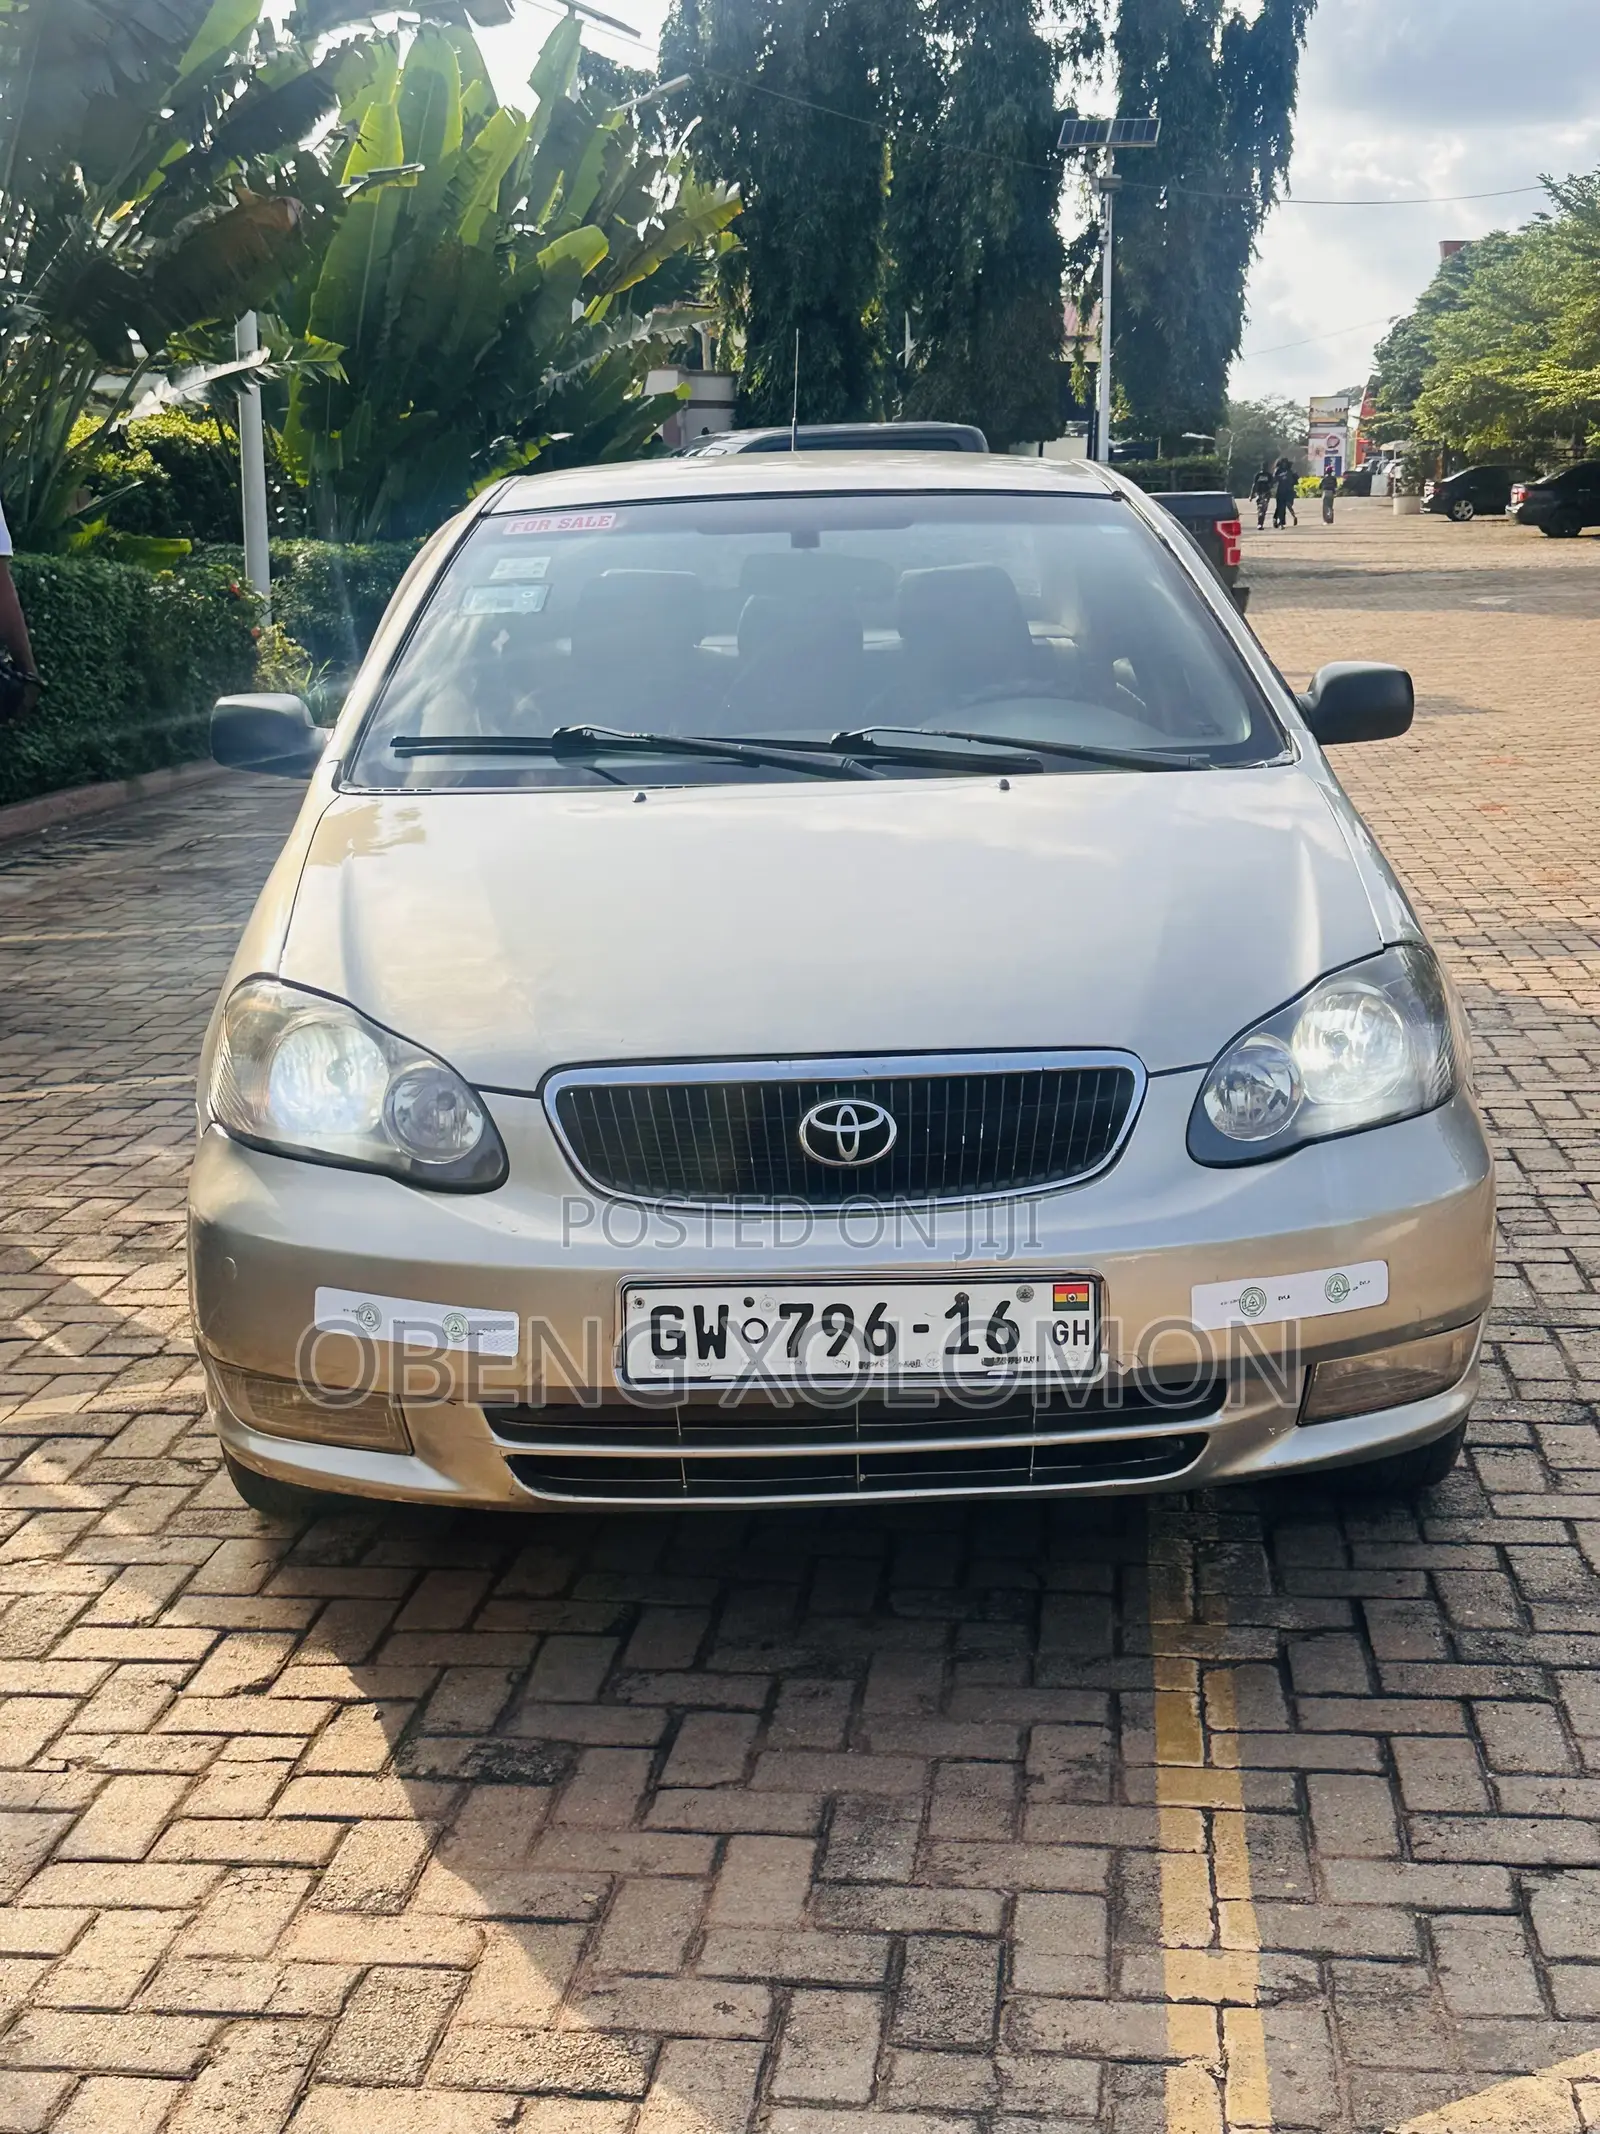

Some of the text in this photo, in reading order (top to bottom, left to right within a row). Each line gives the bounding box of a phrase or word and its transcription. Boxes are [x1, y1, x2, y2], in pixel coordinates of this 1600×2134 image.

[509, 515, 613, 533] FOR SALE
[650, 1303, 730, 1359] GW
[1052, 1319, 1091, 1346] GH
